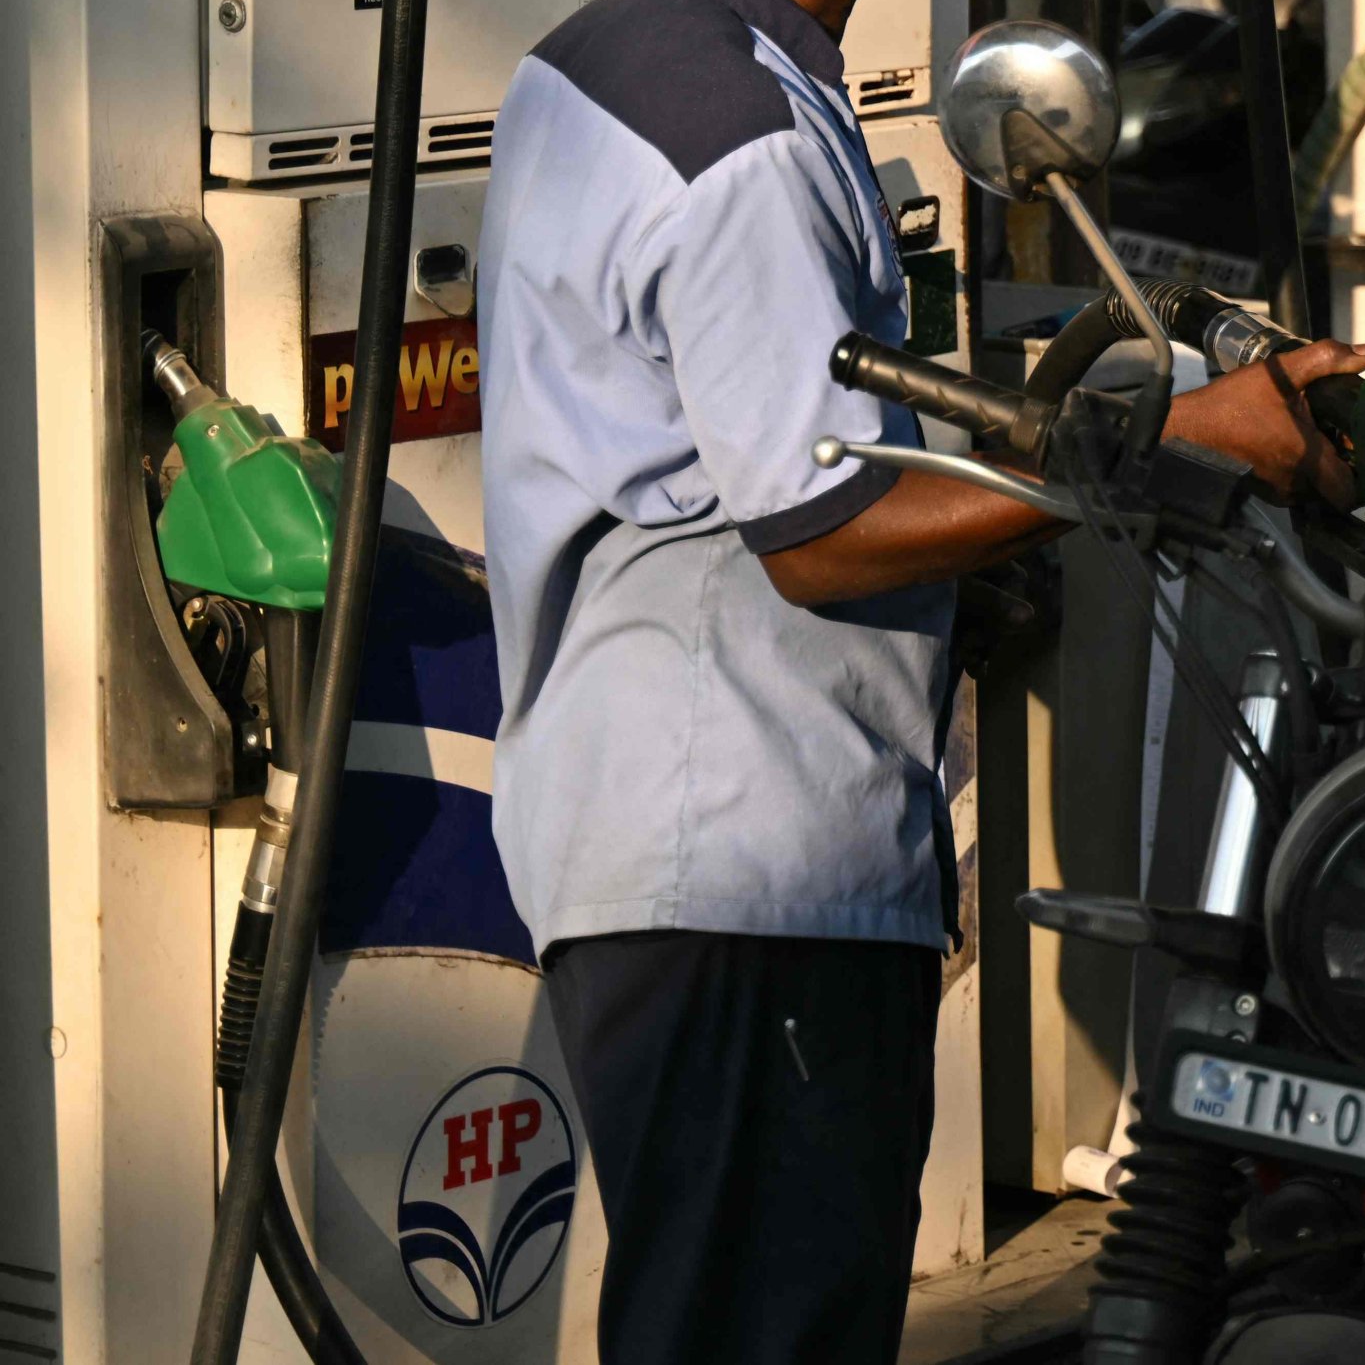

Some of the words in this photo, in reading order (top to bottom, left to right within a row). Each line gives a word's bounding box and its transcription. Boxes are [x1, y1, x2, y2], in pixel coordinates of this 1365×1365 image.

[324, 339, 480, 429] pWe
[1193, 1096, 1226, 1120] IND
[1244, 1070, 1308, 1136] TN
[442, 1098, 542, 1192] HP
